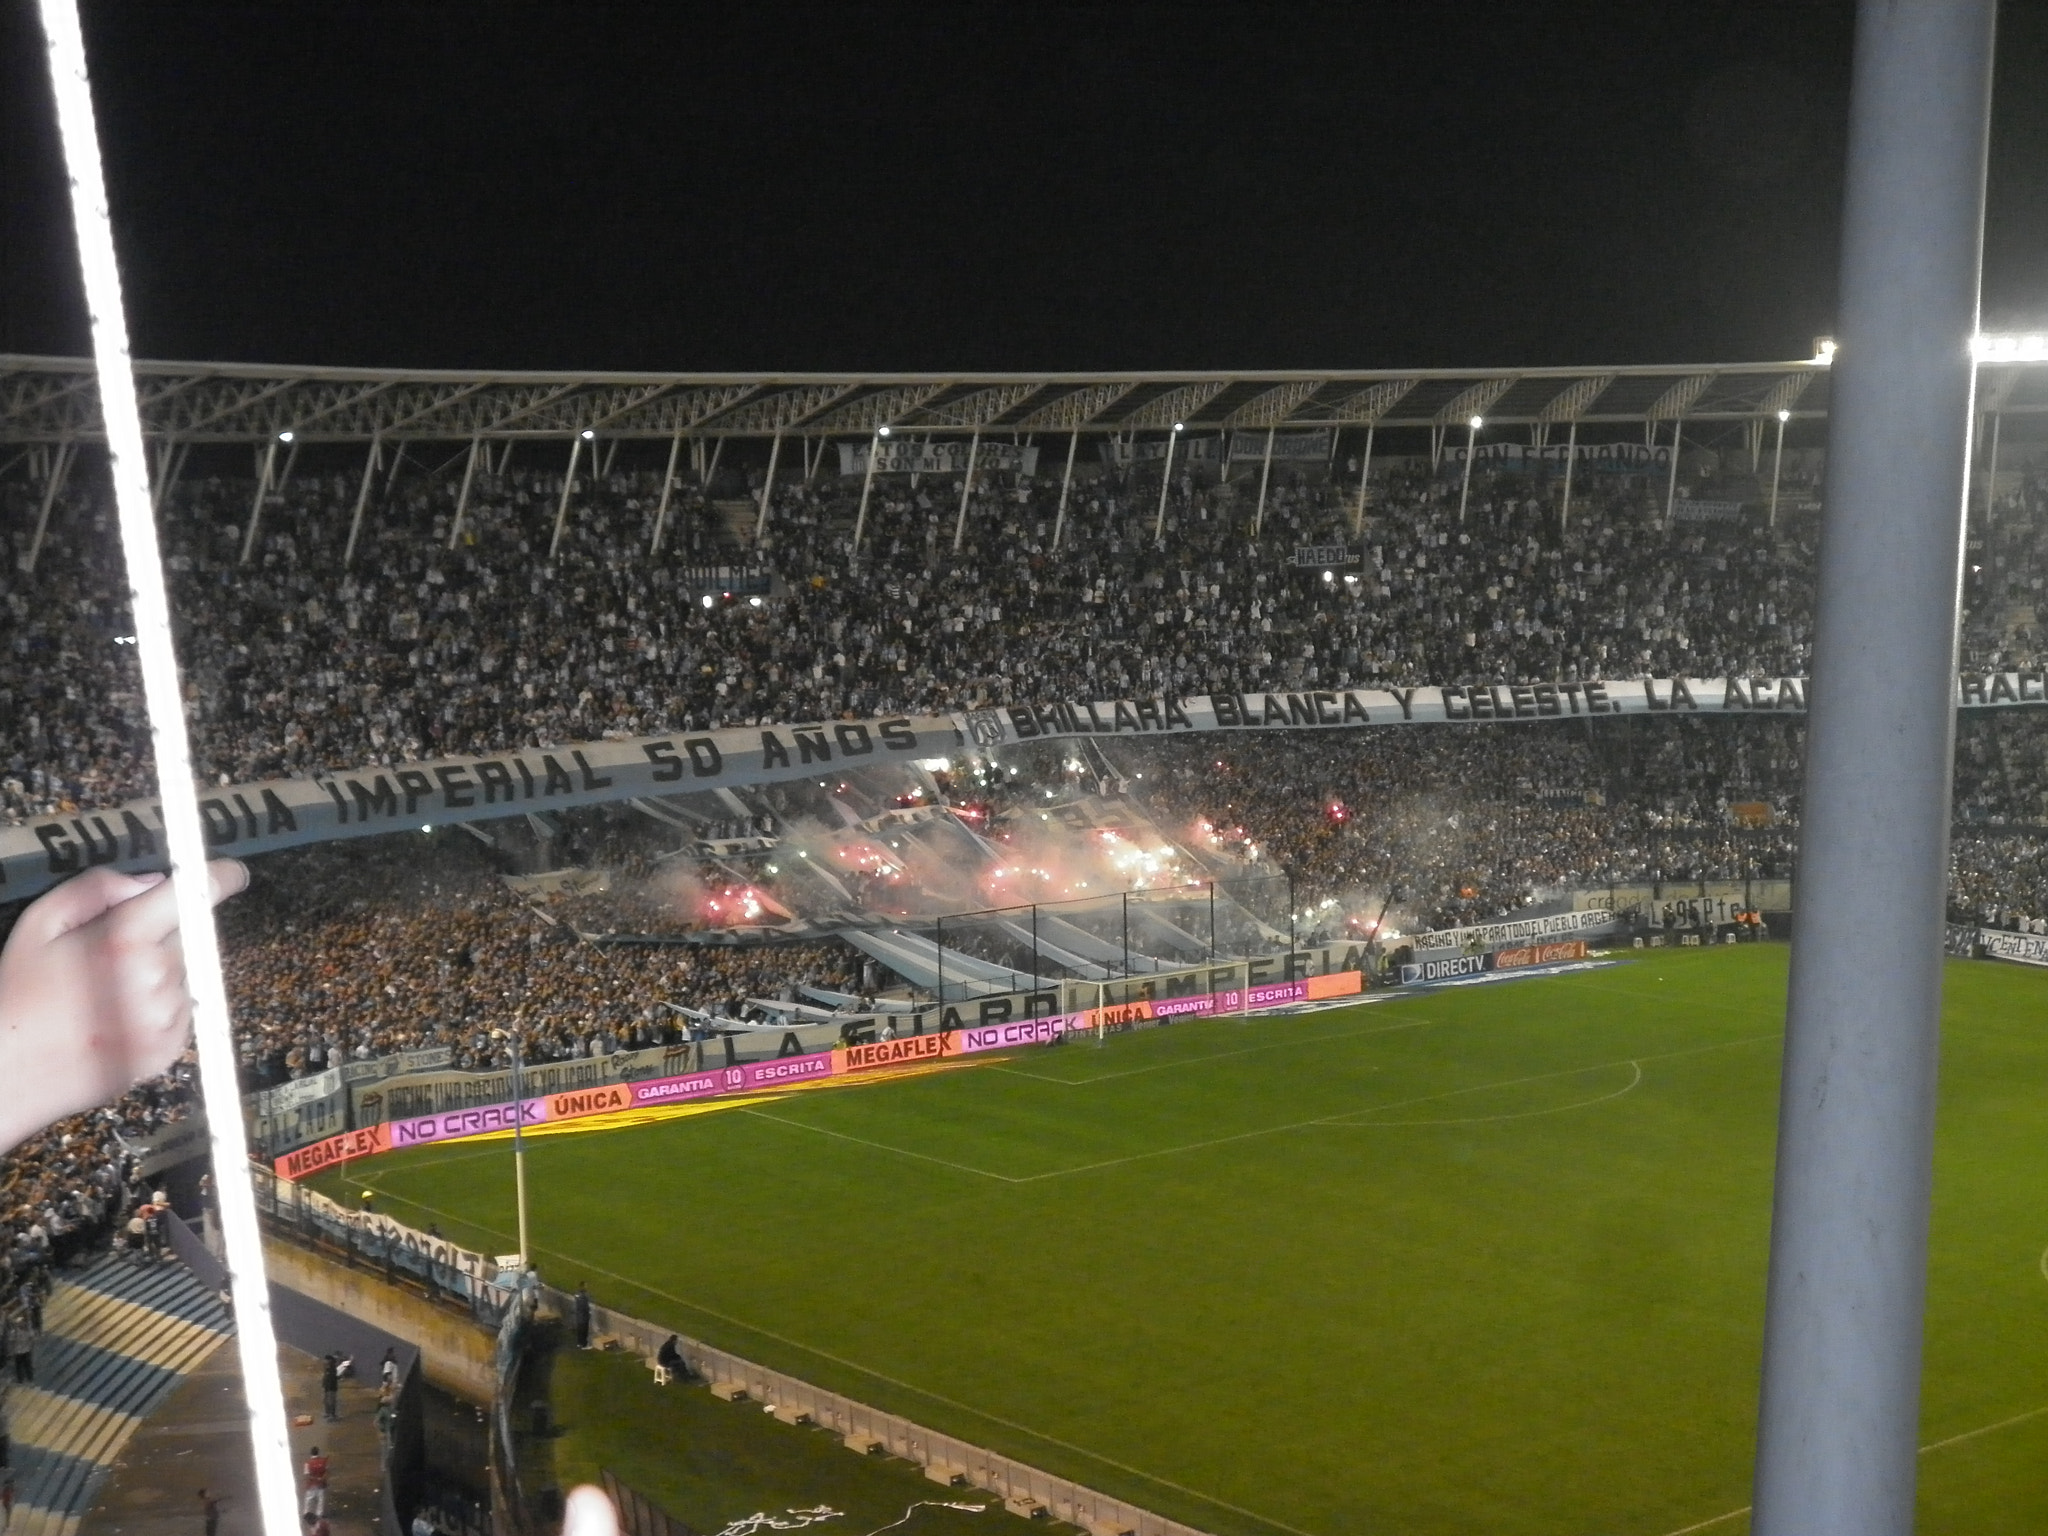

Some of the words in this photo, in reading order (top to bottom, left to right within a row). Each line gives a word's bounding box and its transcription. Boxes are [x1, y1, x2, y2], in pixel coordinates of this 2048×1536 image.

[876, 457, 915, 470] SON
[923, 457, 941, 470] MI
[1212, 691, 1370, 727] BLANCA
[1386, 686, 1418, 720] Y
[1643, 679, 1697, 710] LA
[1722, 678, 1810, 710] ACA
[34, 787, 298, 874] GUADIA
[323, 748, 612, 825] IMPERIAL
[641, 737, 723, 782] 50
[760, 718, 917, 770] AÑOS
[1414, 931, 1452, 950] RACING
[1482, 924, 1506, 943] PARA
[1506, 921, 1530, 940] TODO
[1530, 920, 1543, 936] EL
[1543, 914, 1578, 934] PUEBLO
[1426, 954, 1485, 980] DIRECTV
[723, 1031, 805, 1066] LA
[1141, 941, 1384, 1002] IMPERIA
[1225, 991, 1239, 1006] 10
[1248, 986, 1303, 1003] ESCRITA
[845, 1031, 953, 1068] MEGAFLEX
[967, 1029, 999, 1048] NO
[1004, 1015, 1077, 1043] CRACK
[637, 1076, 714, 1100] GARANTIA
[725, 1068, 742, 1085] 10
[755, 1060, 826, 1081] ESCRITA
[554, 1090, 623, 1116] ÚNICA
[398, 1119, 437, 1142] NO
[444, 1102, 538, 1136] CRACK
[287, 1125, 382, 1175] MEGAFLEX
